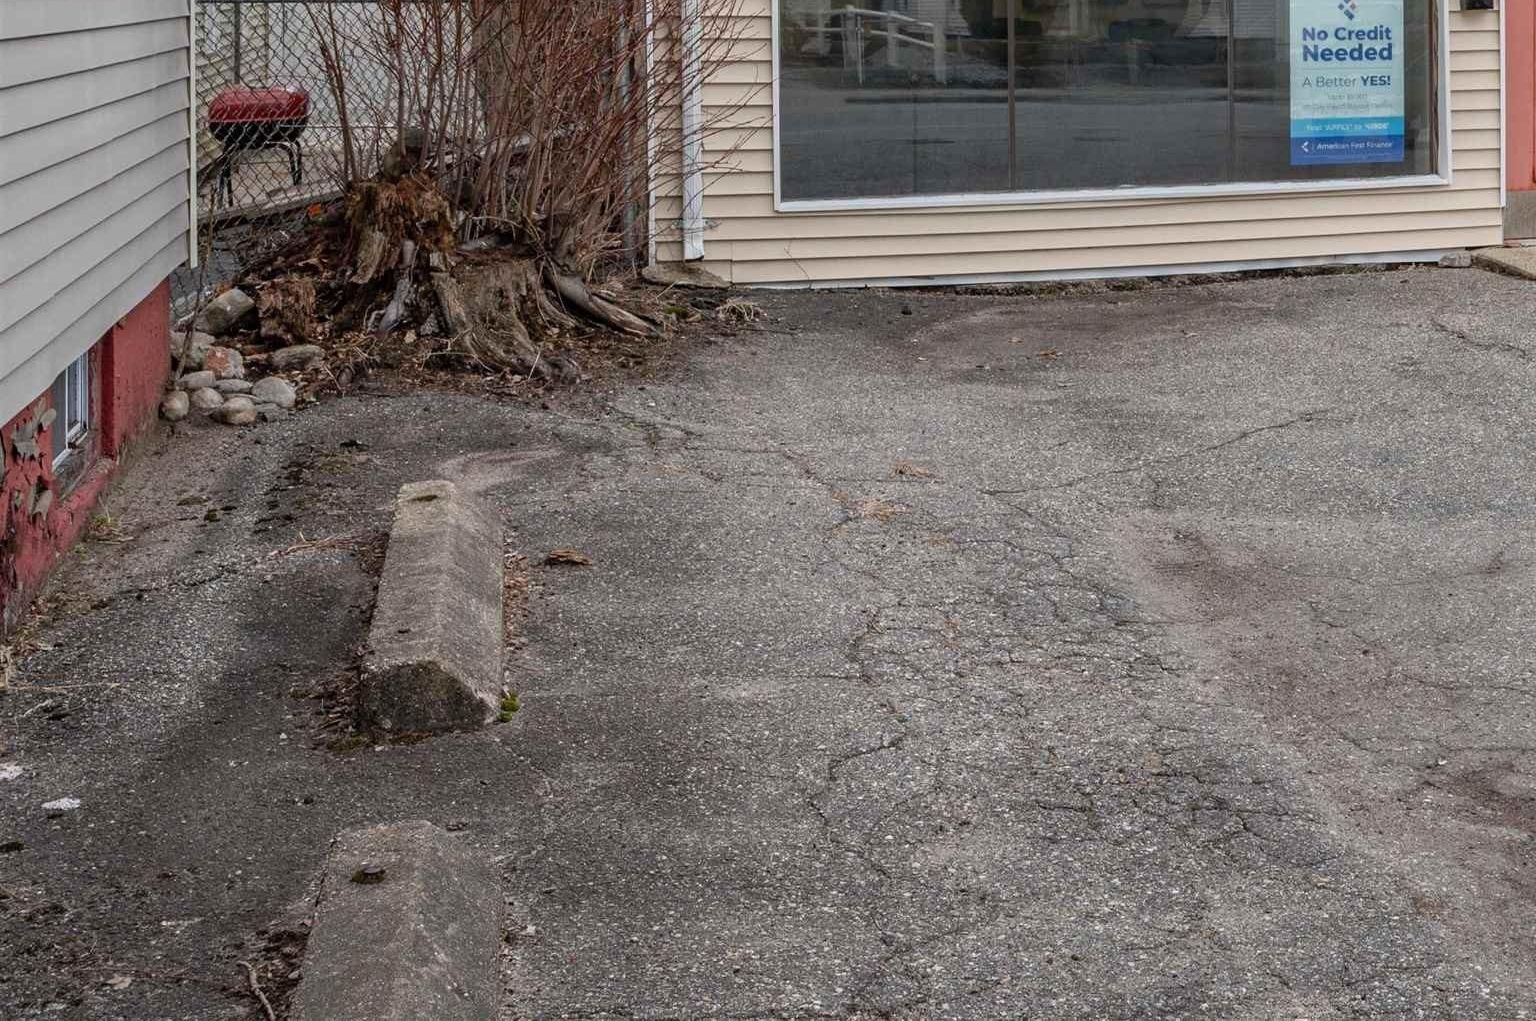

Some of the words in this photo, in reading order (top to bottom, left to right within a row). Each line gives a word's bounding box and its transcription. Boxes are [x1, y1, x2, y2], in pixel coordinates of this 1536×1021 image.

[1302, 27, 1328, 41] No
[1334, 25, 1392, 41] Credit
[1303, 43, 1393, 62] Needed
[1302, 76, 1312, 88] A
[1315, 76, 1356, 88] Better
[1360, 75, 1391, 87] YES!
